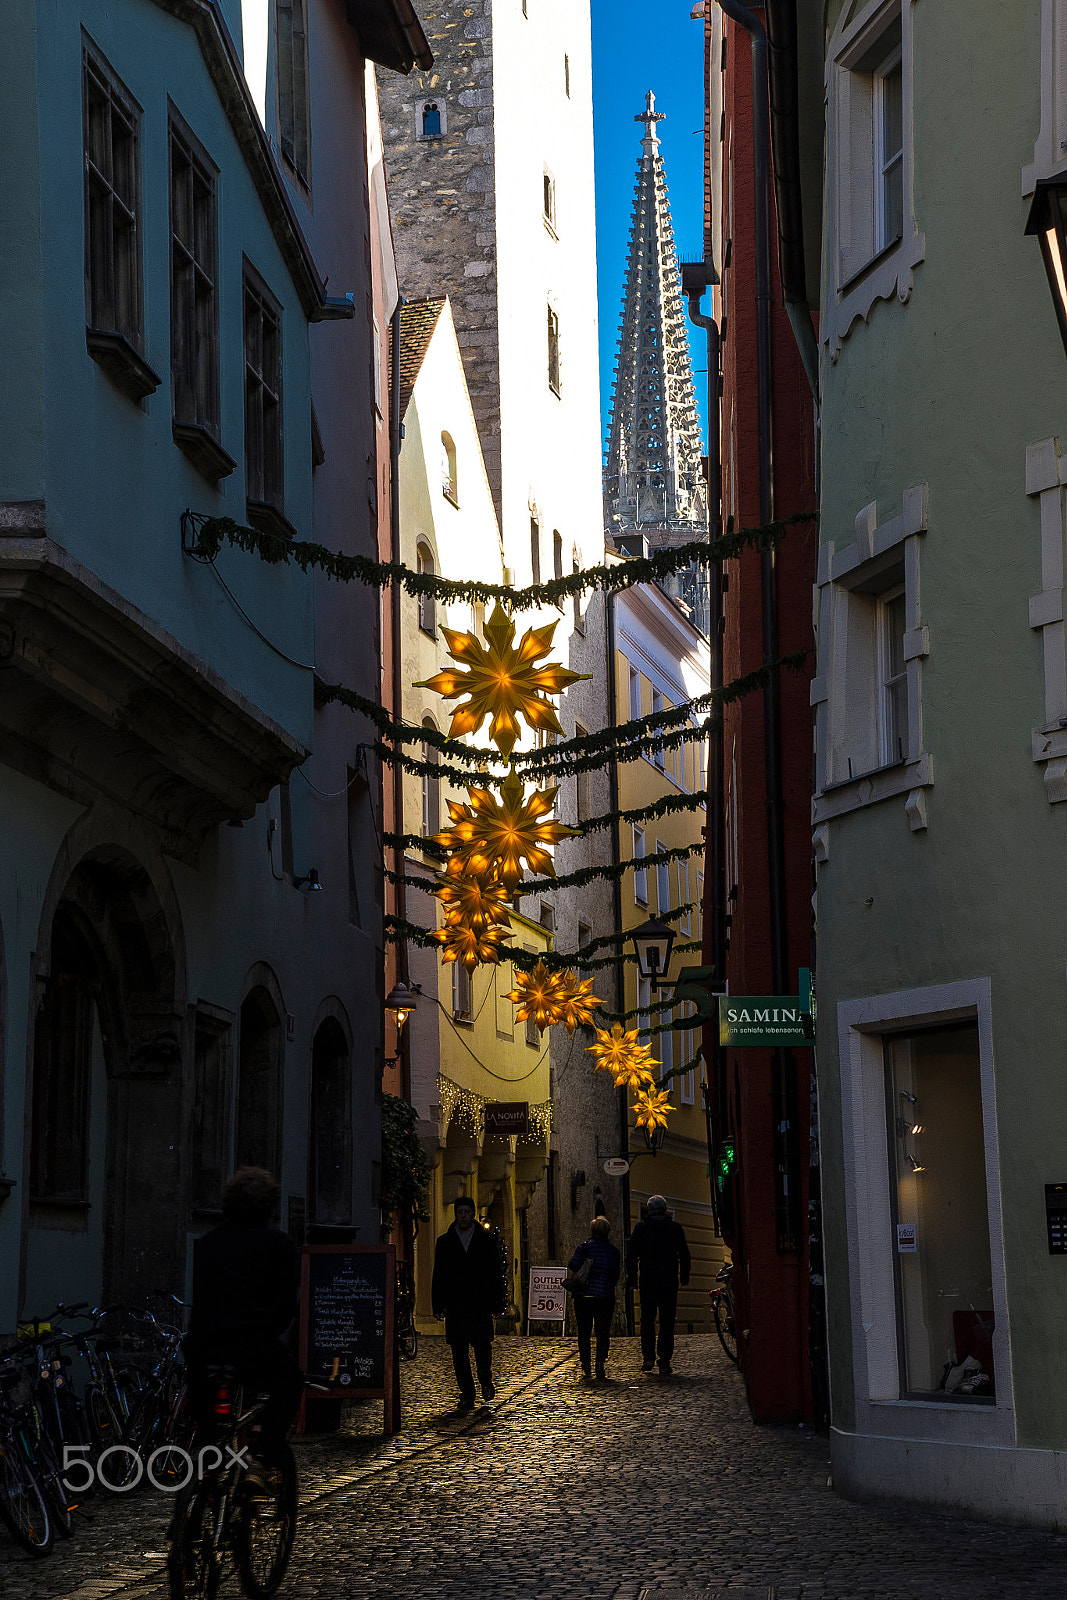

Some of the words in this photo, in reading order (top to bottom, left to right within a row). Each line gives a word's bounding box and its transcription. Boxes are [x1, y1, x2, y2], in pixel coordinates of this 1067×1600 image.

[740, 1026, 764, 1034] schlafe
[533, 1276, 563, 1284] OUTLET
[531, 1299, 564, 1311] -50%
